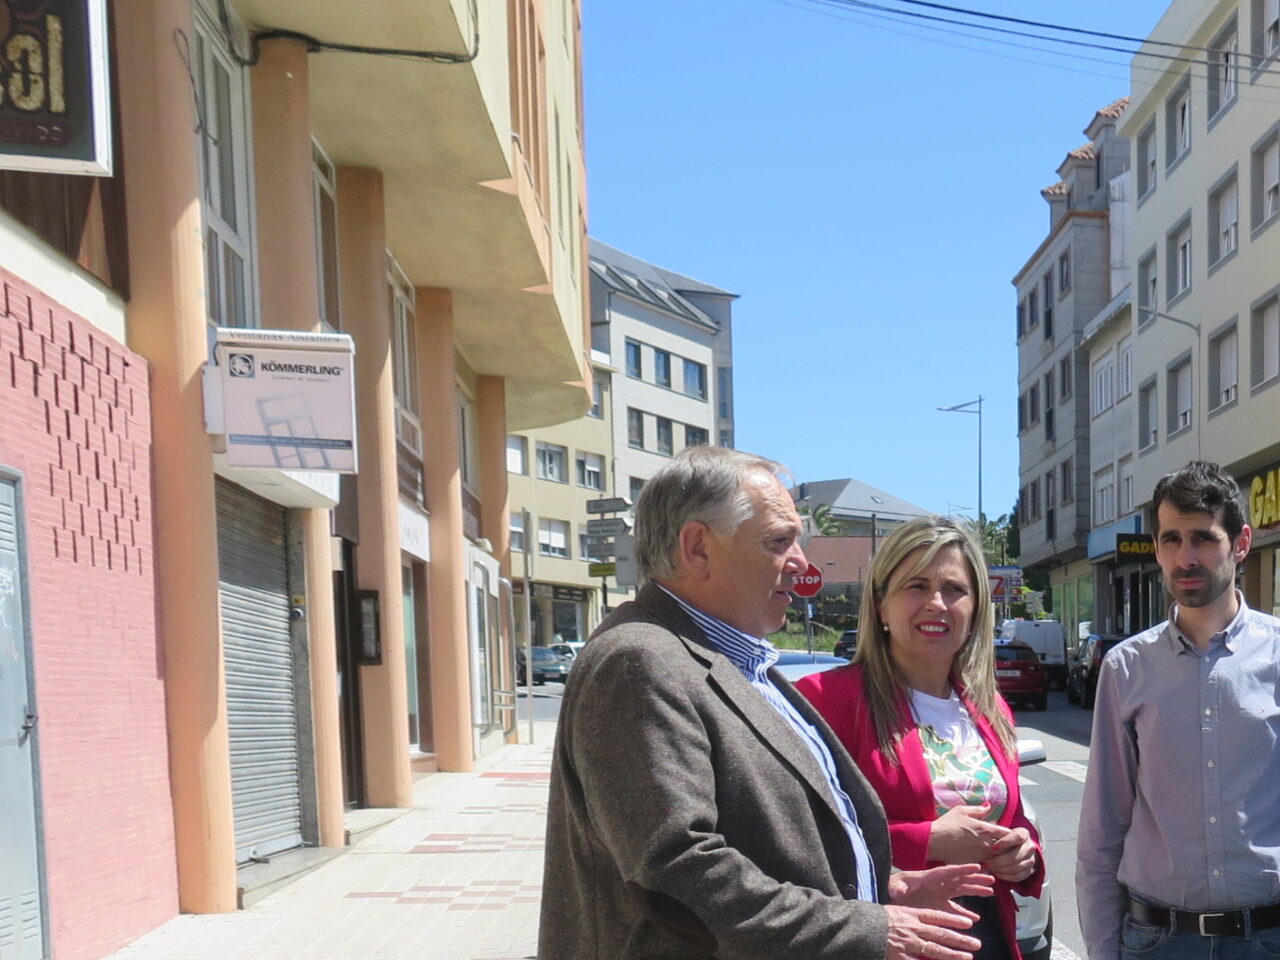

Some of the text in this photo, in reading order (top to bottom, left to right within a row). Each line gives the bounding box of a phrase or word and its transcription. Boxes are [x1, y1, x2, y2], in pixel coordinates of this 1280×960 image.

[261, 360, 341, 376] KÖMMERLING
[1119, 541, 1156, 553] GADI
[791, 576, 821, 585] STOP
